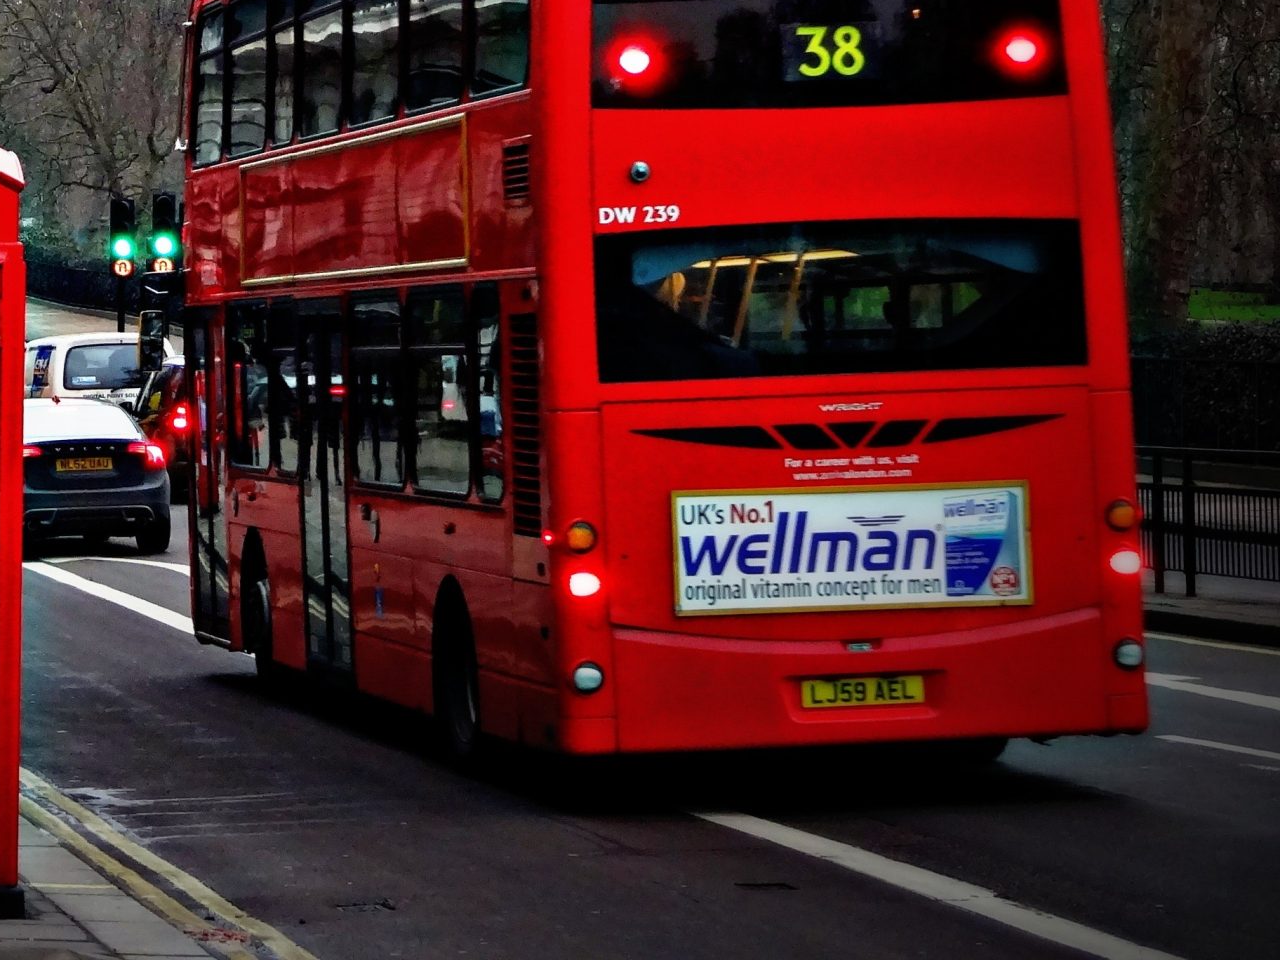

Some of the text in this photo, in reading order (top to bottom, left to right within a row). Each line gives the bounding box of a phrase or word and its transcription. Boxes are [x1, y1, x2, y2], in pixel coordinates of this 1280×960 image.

[795, 25, 865, 77] 38
[598, 204, 680, 224] DW 239
[818, 402, 883, 412] WRIGHT
[784, 458, 802, 468] For
[804, 459, 813, 467] a
[681, 500, 775, 525] UK's No.1
[680, 510, 937, 577] wellman
[684, 573, 941, 606] original vitamin concept for men
[810, 678, 916, 705] LJ59 AEL
